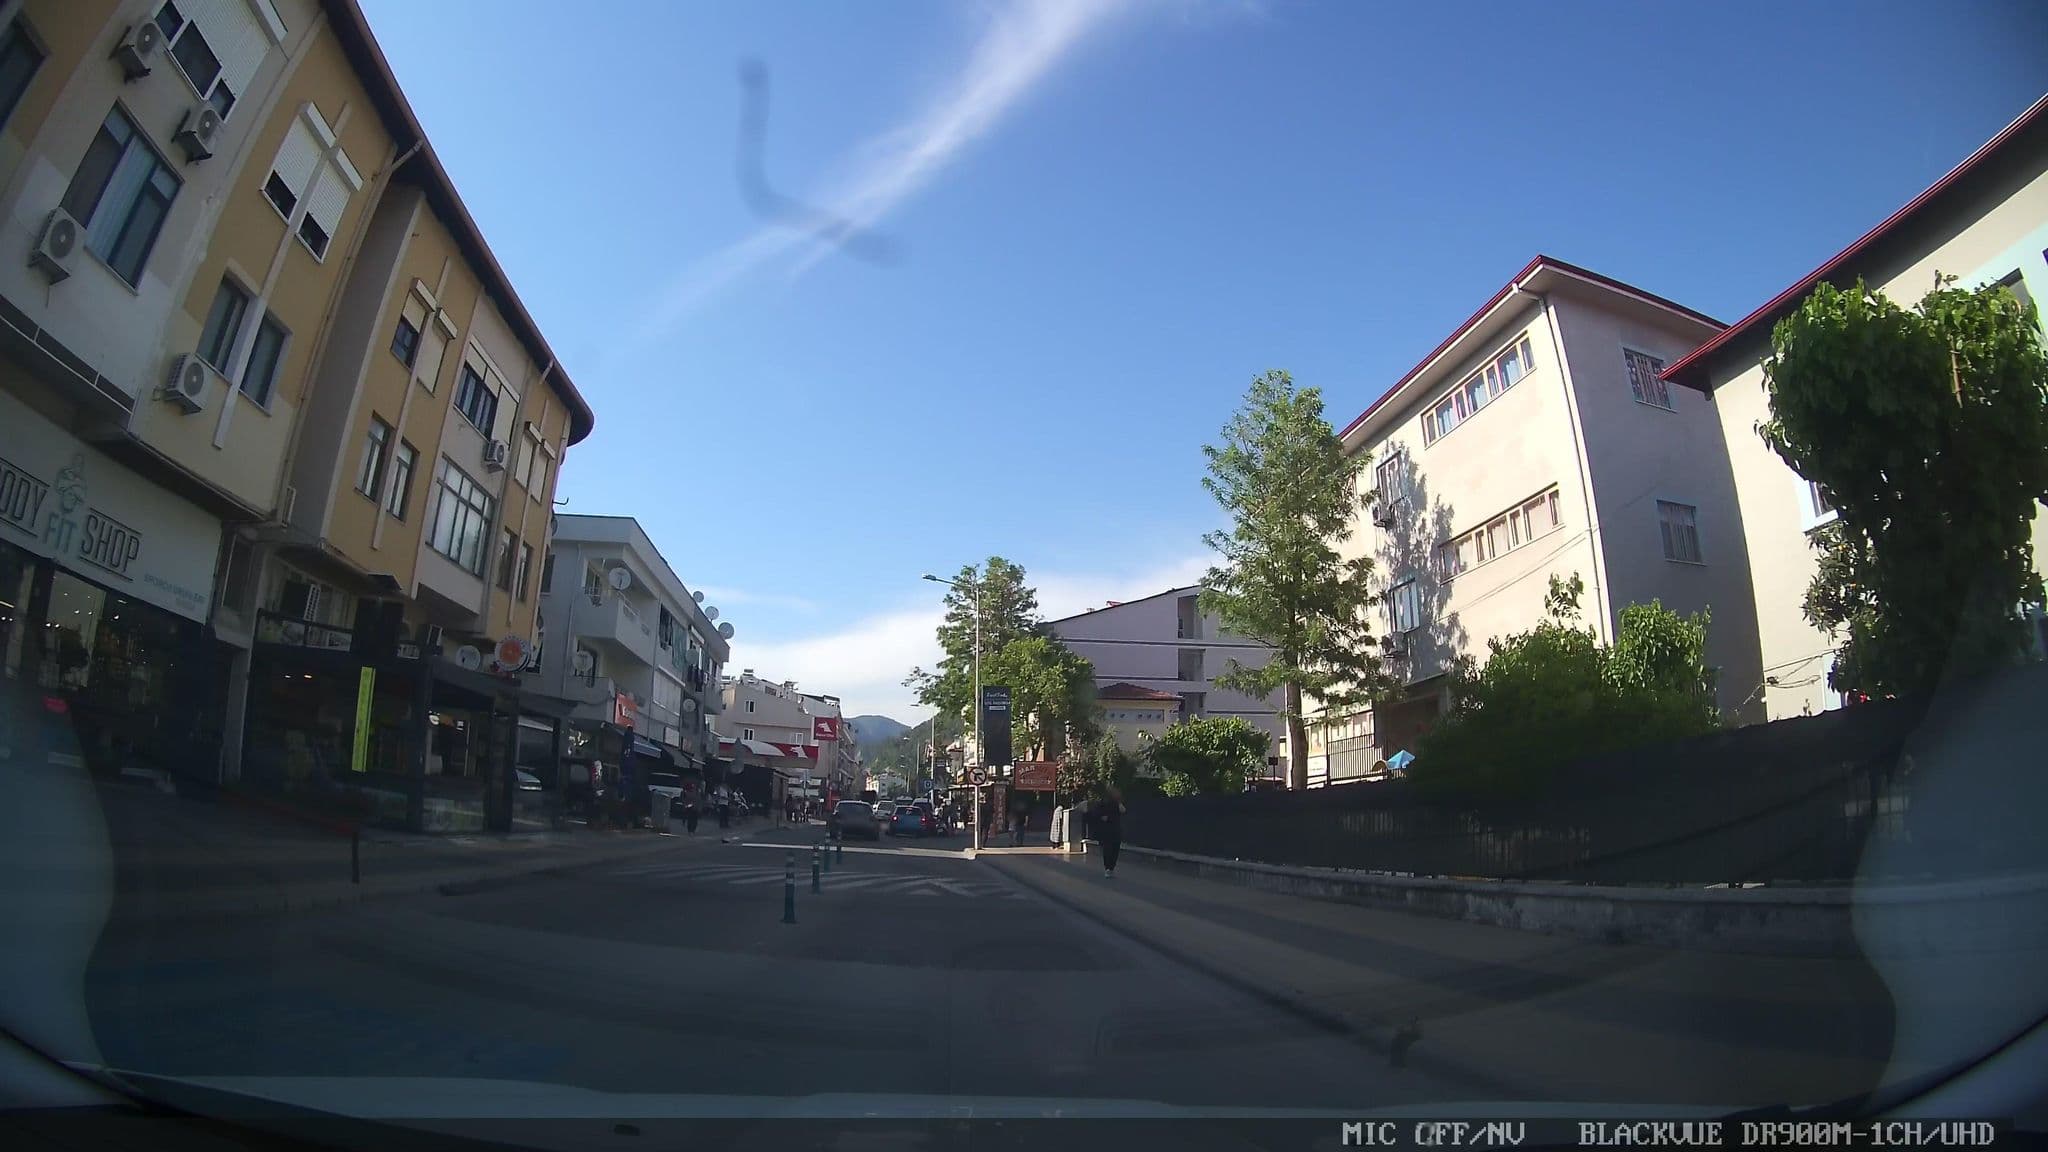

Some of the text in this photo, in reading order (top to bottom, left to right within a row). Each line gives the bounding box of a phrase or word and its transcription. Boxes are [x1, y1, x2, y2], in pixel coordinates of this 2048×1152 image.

[0, 469, 140, 573] ODY FIT SHOP
